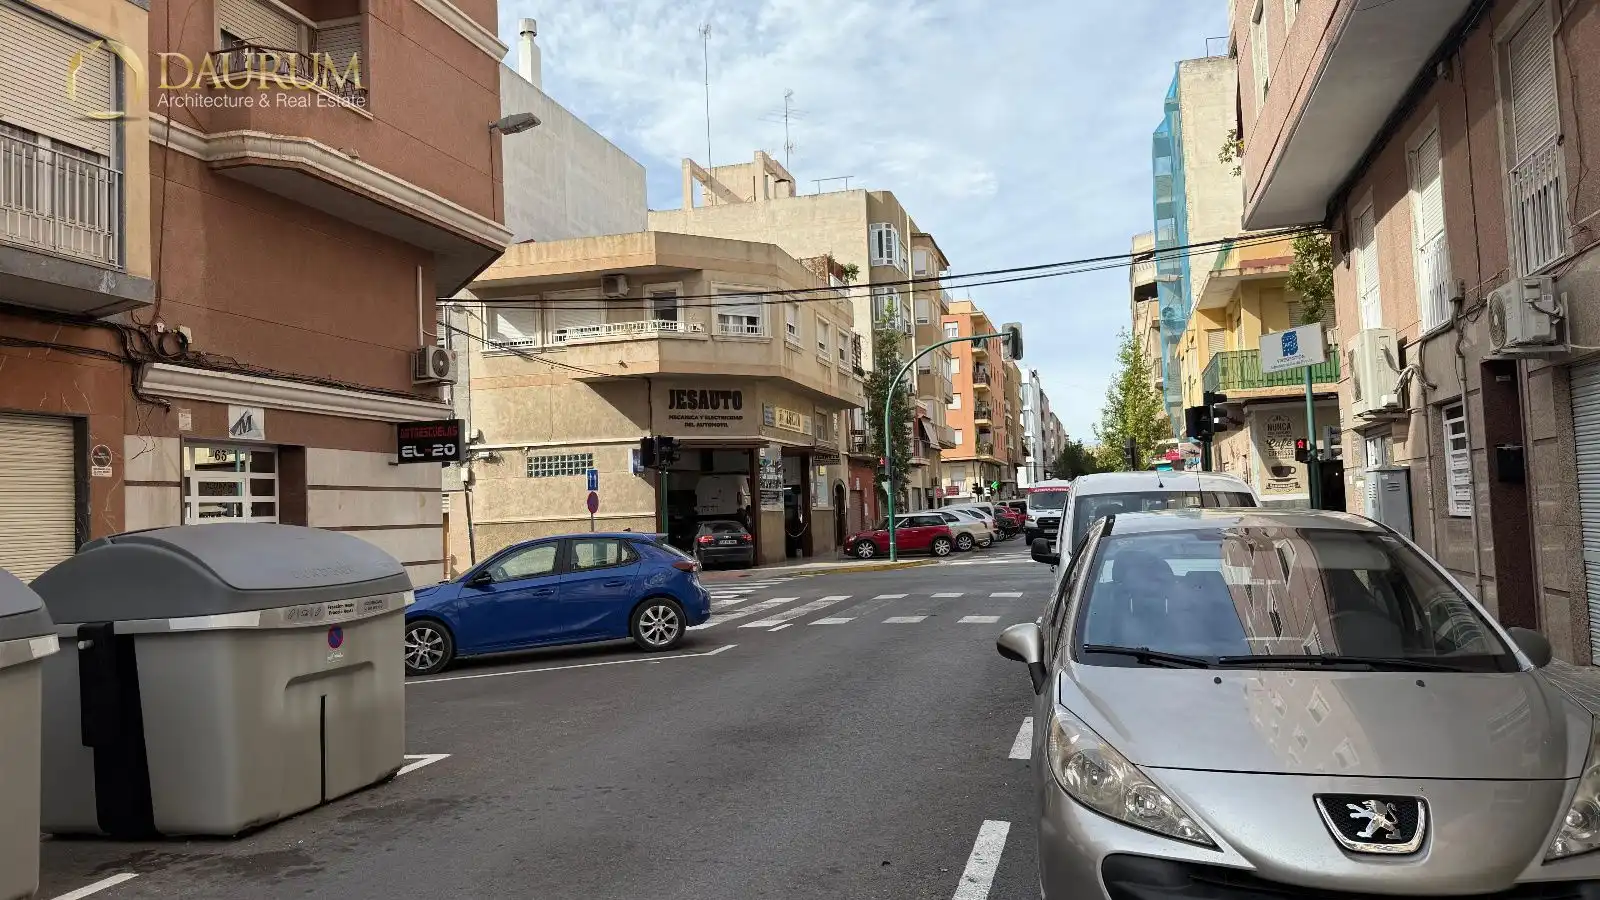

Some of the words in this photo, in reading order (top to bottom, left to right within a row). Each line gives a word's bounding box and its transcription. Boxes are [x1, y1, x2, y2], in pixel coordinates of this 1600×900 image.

[668, 389, 743, 410] JESAUTO
[1268, 423, 1292, 431] NUNCA
[1266, 438, 1293, 450] Café
[214, 449, 227, 461] 63
[401, 443, 456, 458] EL-20
